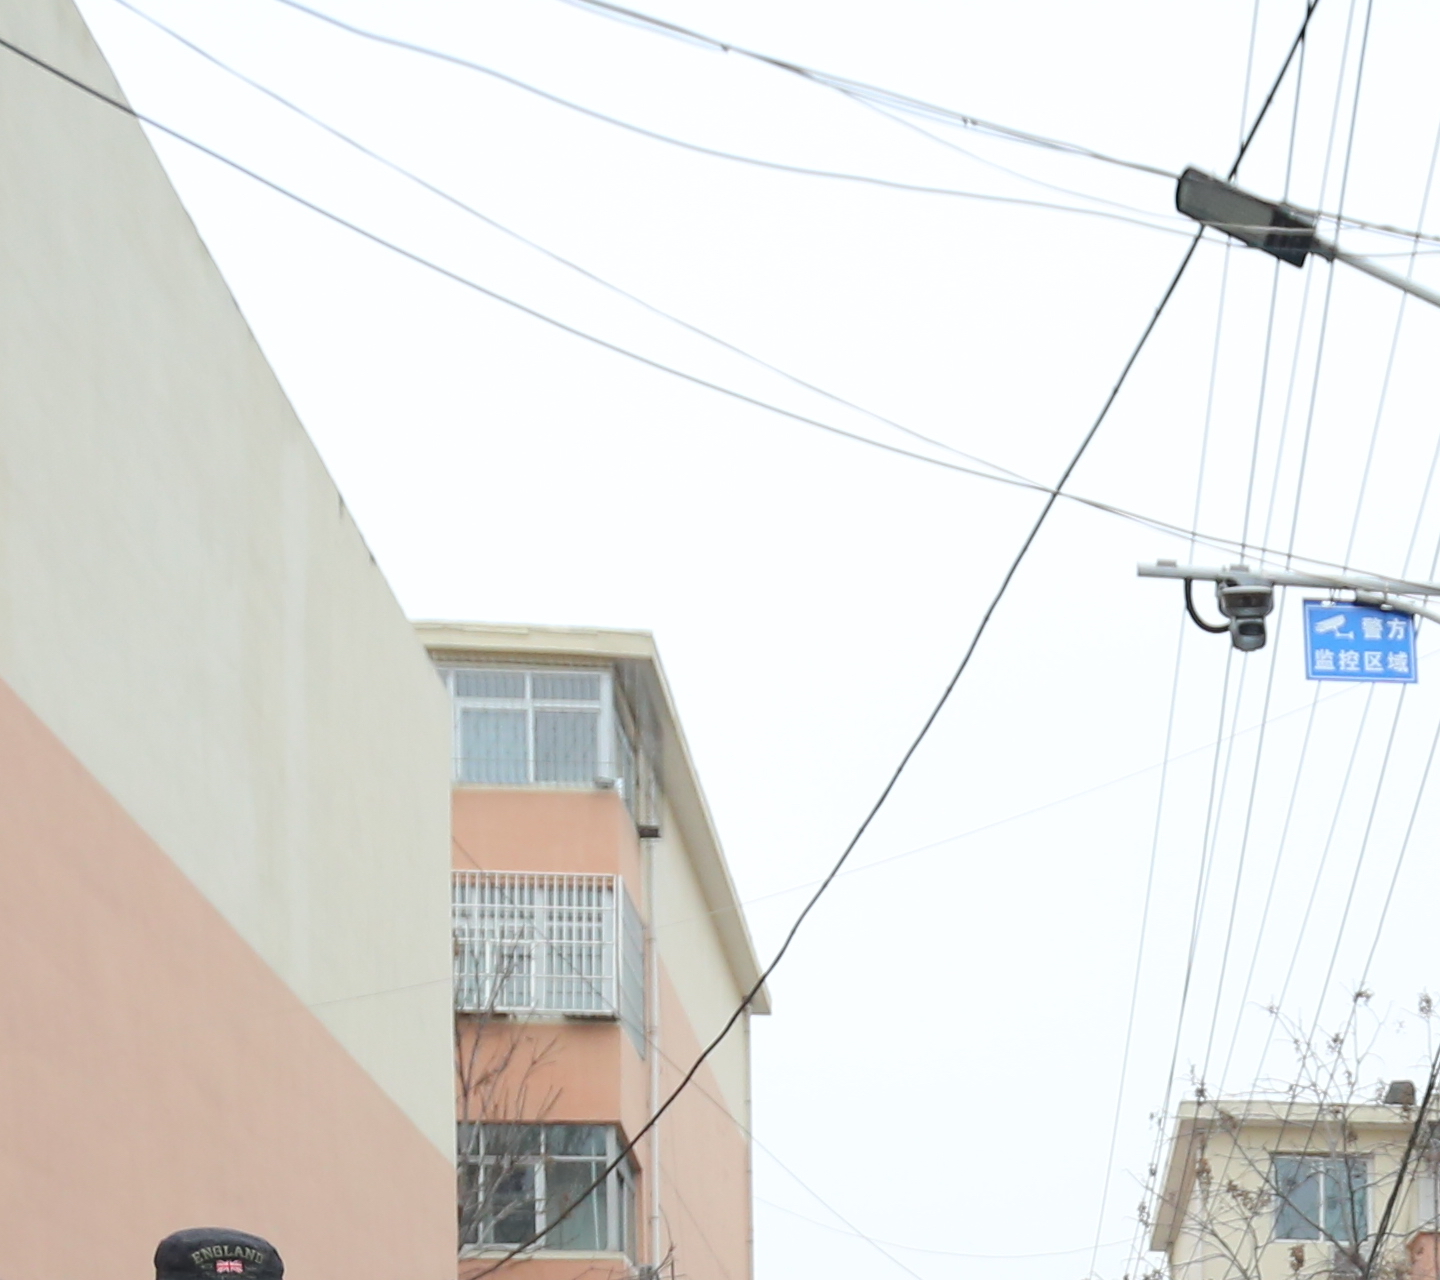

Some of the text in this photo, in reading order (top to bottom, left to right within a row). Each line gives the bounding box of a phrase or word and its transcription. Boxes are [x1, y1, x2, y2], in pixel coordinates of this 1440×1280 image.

[1362, 617, 1407, 639] 警方
[1314, 648, 1409, 673] 监控区域
[191, 1245, 265, 1265] ENGLAND
